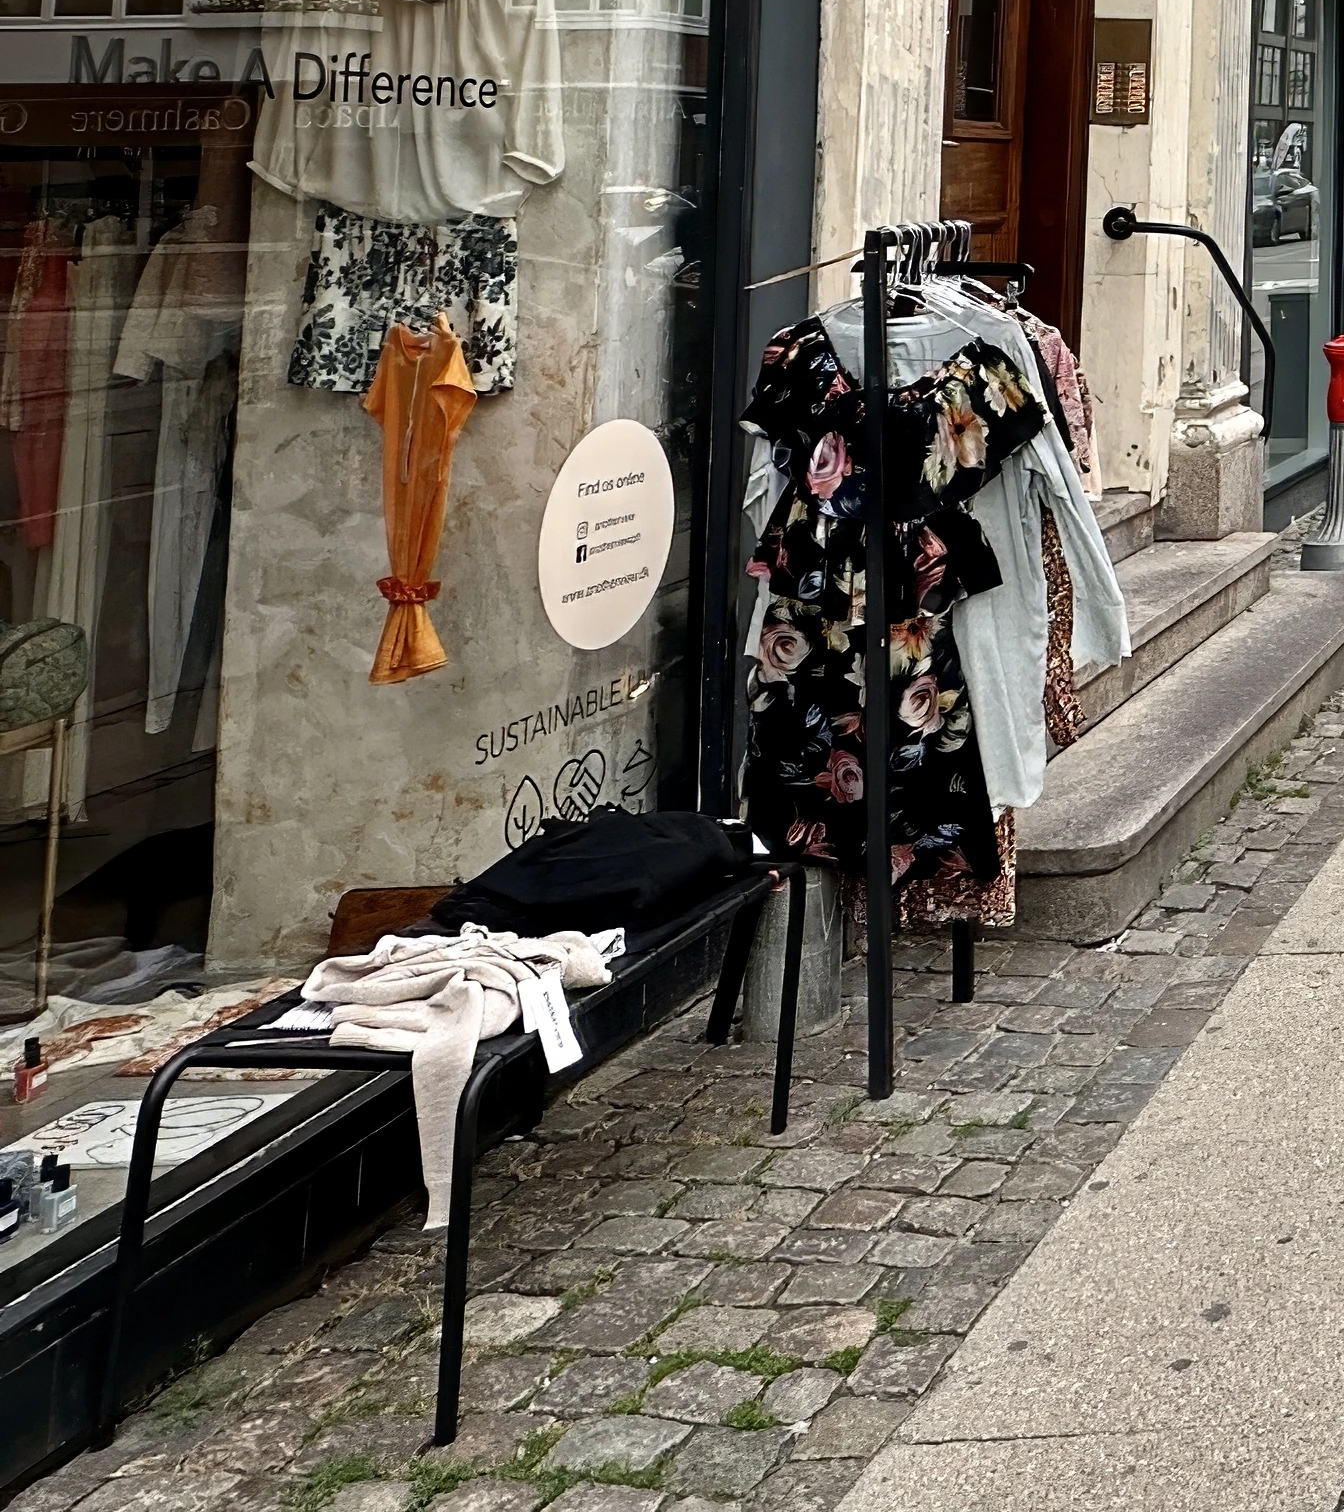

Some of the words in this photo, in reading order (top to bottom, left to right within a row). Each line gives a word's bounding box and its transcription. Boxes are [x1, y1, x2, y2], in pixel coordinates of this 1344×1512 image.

[69, 35, 221, 85] Make
[240, 47, 275, 100] A
[293, 51, 498, 109] Difference
[475, 678, 623, 765] SUSTAINABLE
